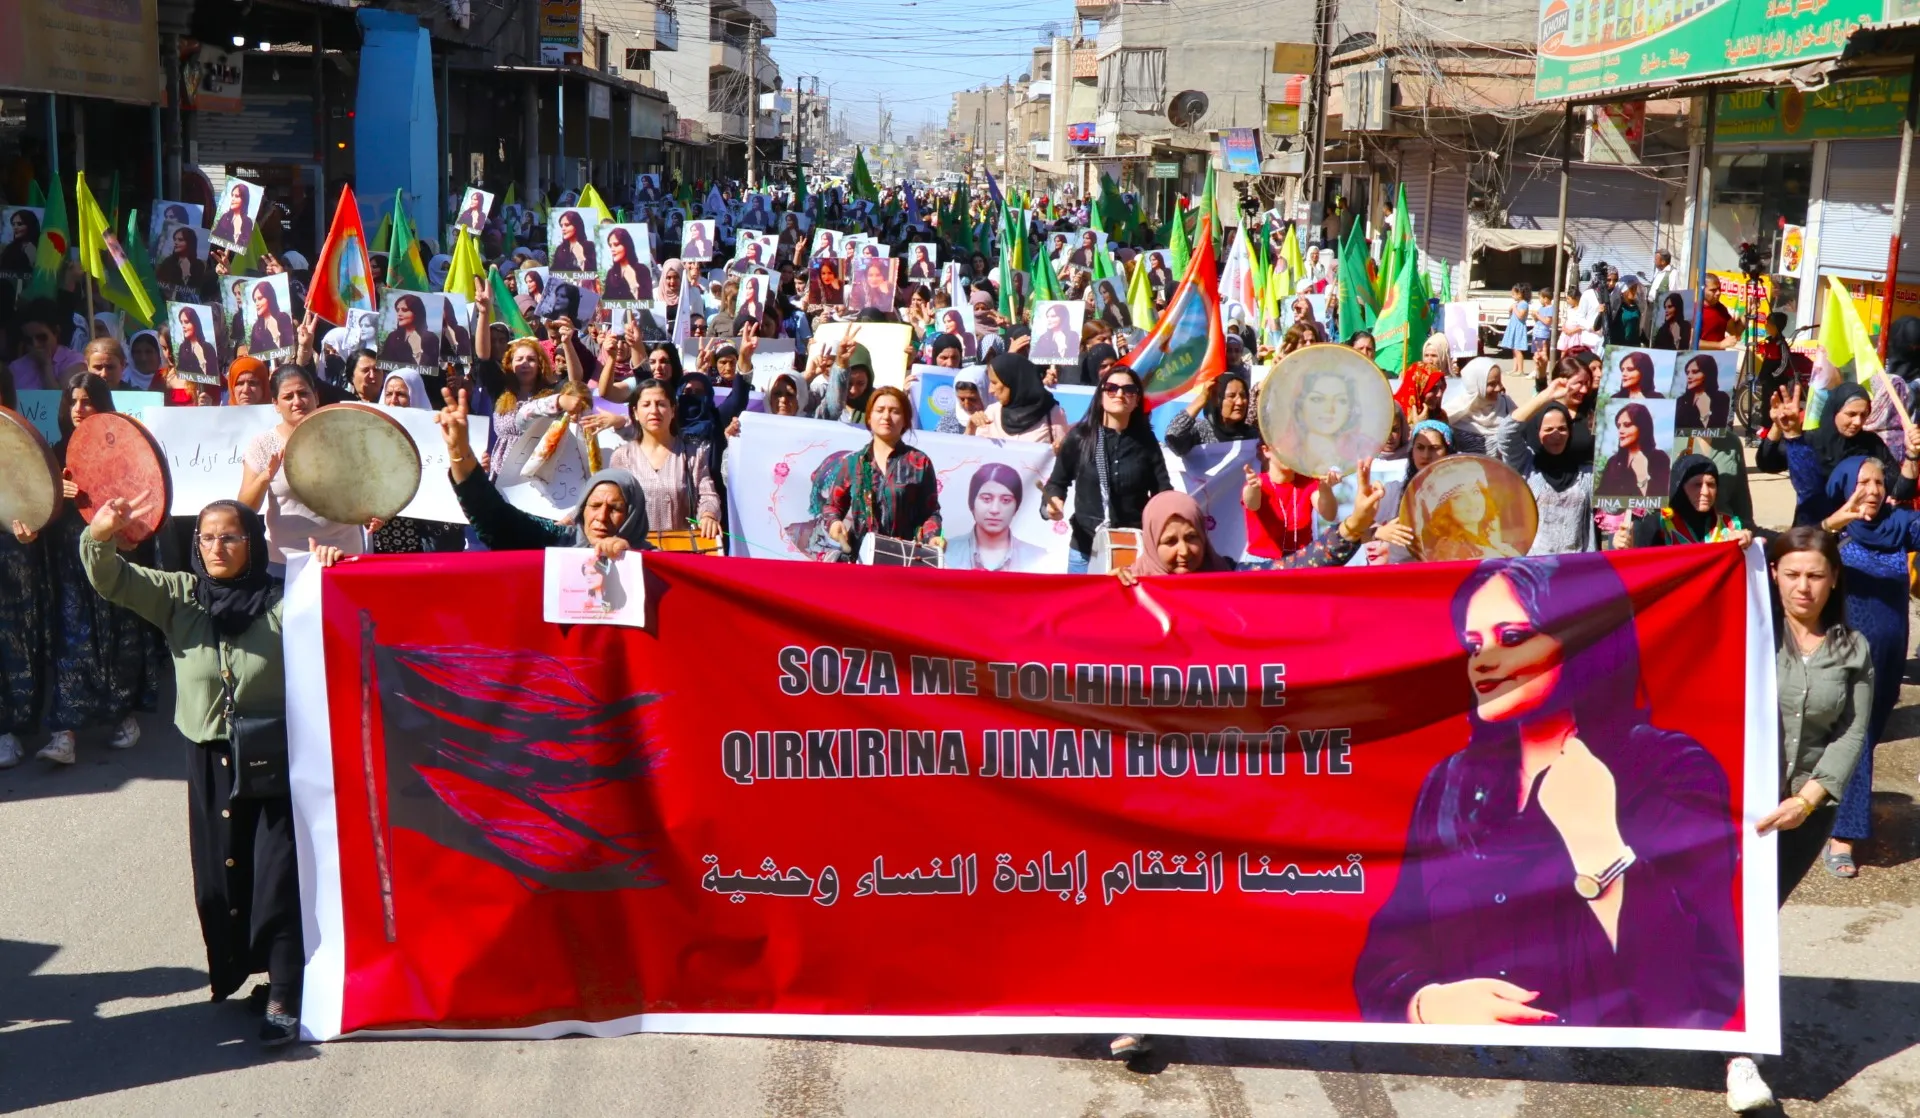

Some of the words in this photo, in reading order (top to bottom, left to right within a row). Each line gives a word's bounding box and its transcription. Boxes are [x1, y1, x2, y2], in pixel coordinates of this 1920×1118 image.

[1542, 10, 1569, 41] KHOSH
[604, 300, 622, 309] JINA
[1595, 498, 1621, 509] JINA
[778, 645, 900, 696] SOZA
[910, 654, 978, 696] ME
[988, 662, 1247, 708] TOLHILDAN
[1261, 662, 1286, 708] E
[722, 728, 970, 785] QIRKIRINA
[979, 729, 1112, 778] JINAN
[1126, 725, 1290, 778] HOVÎTÎ
[1297, 727, 1353, 776] YE
[701, 854, 840, 907] وحشية
[853, 852, 977, 897] النساء
[993, 849, 1088, 905] إبادة
[1101, 849, 1223, 906] انتقام
[1238, 852, 1365, 896] قسمنا
